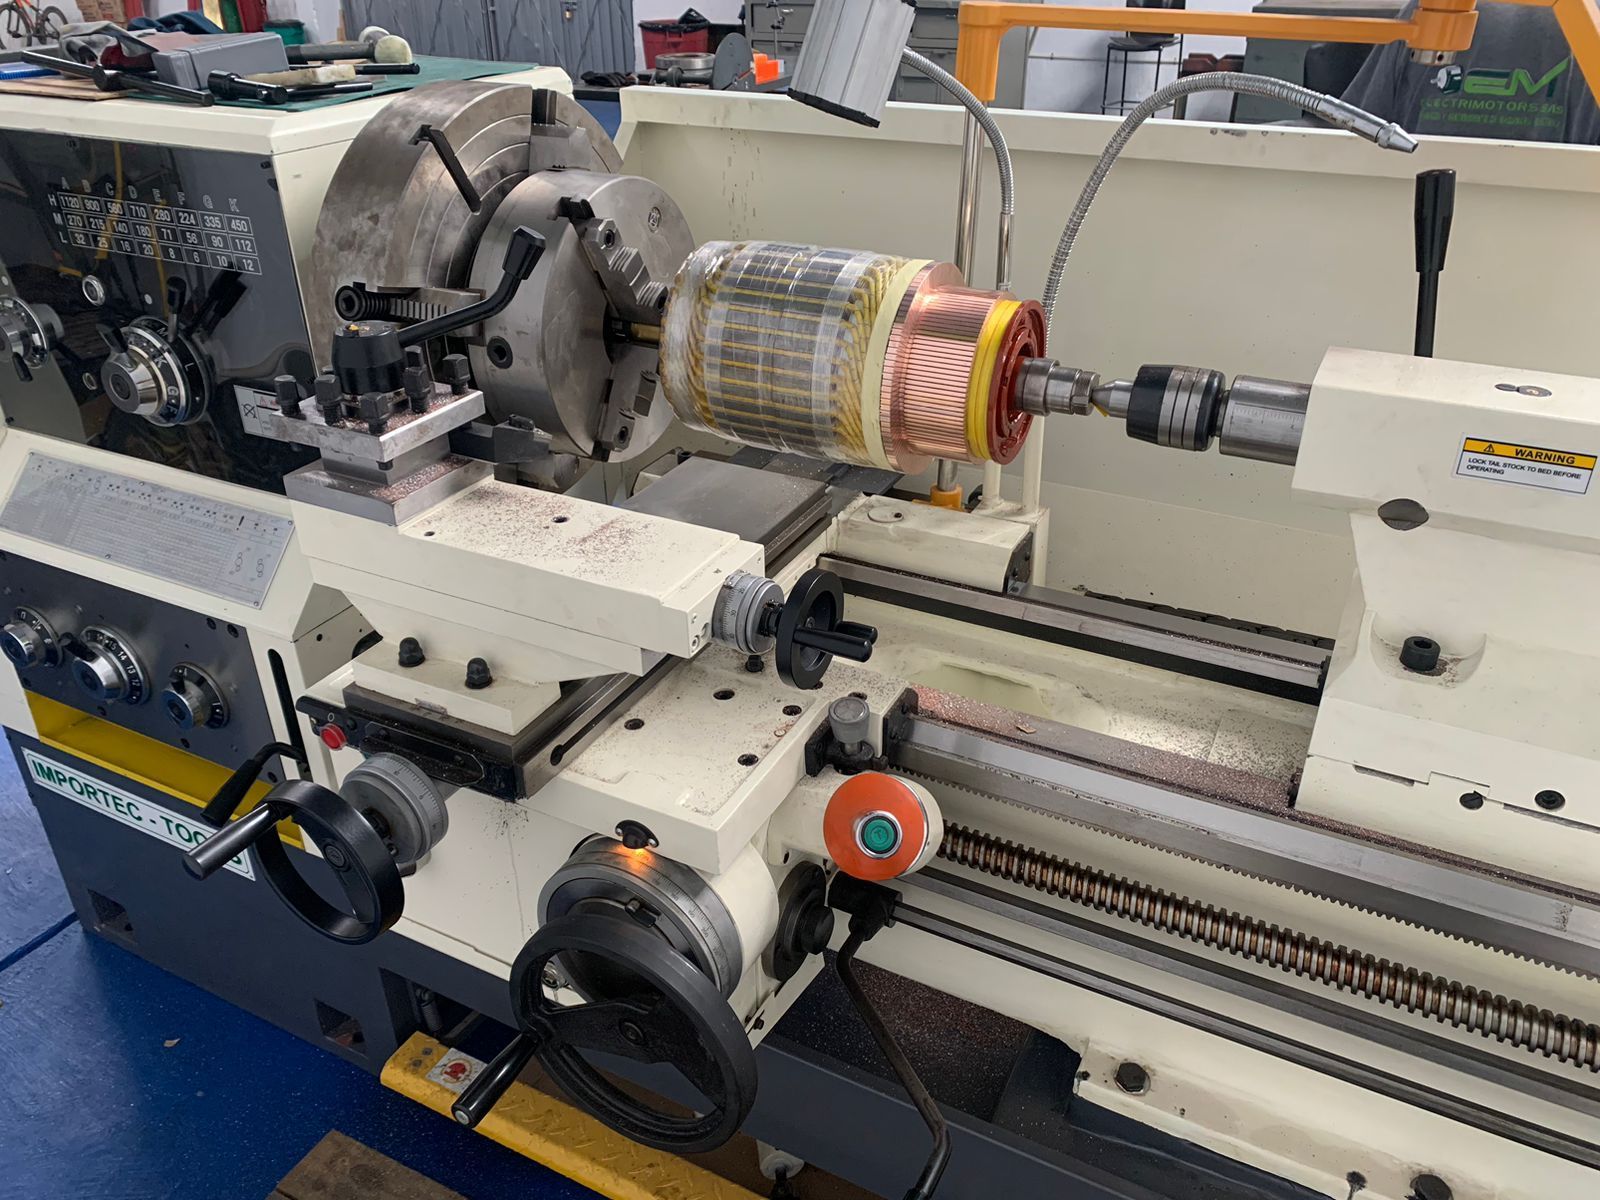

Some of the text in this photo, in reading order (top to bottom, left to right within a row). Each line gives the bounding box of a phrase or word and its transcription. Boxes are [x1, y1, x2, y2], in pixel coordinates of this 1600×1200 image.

[1421, 98, 1538, 113] LECTRIMOTORS
[62, 177, 70, 190] A
[105, 183, 114, 196] C
[128, 186, 137, 198] D
[152, 189, 160, 202] E
[48, 194, 57, 206] H
[61, 196, 79, 208] 1120
[84, 200, 100, 211] 900
[130, 206, 146, 218] 710
[154, 209, 170, 221] 280
[179, 212, 195, 224] 224
[204, 216, 221, 228] 335
[231, 220, 248, 232] 450
[53, 213, 63, 225] M
[67, 215, 82, 226] 270
[89, 218, 105, 230] 215
[113, 221, 128, 233] 140
[136, 225, 151, 236] 180
[161, 229, 172, 240] 71
[211, 236, 223, 247] 90
[235, 239, 252, 251] 112
[60, 232, 68, 243] L
[74, 233, 86, 244] 32
[97, 237, 108, 248] 25
[142, 244, 154, 255] 20
[168, 248, 175, 259] 8
[193, 252, 200, 262] 6
[216, 256, 228, 266] 10
[242, 259, 254, 271] 12
[155, 356, 167, 368] K
[185, 362, 194, 371] L
[168, 386, 179, 396] G
[1515, 448, 1576, 464] WARNING
[1466, 465, 1505, 475] OPERATING
[1468, 457, 1487, 465] LOCK
[1503, 462, 1526, 471] STOCK
[1538, 467, 1552, 475] BED
[1553, 469, 1582, 480] BEFORE
[108, 641, 117, 651] 15
[118, 651, 127, 660] 14
[127, 666, 136, 674] 13
[32, 760, 142, 821] IMPORTEC
